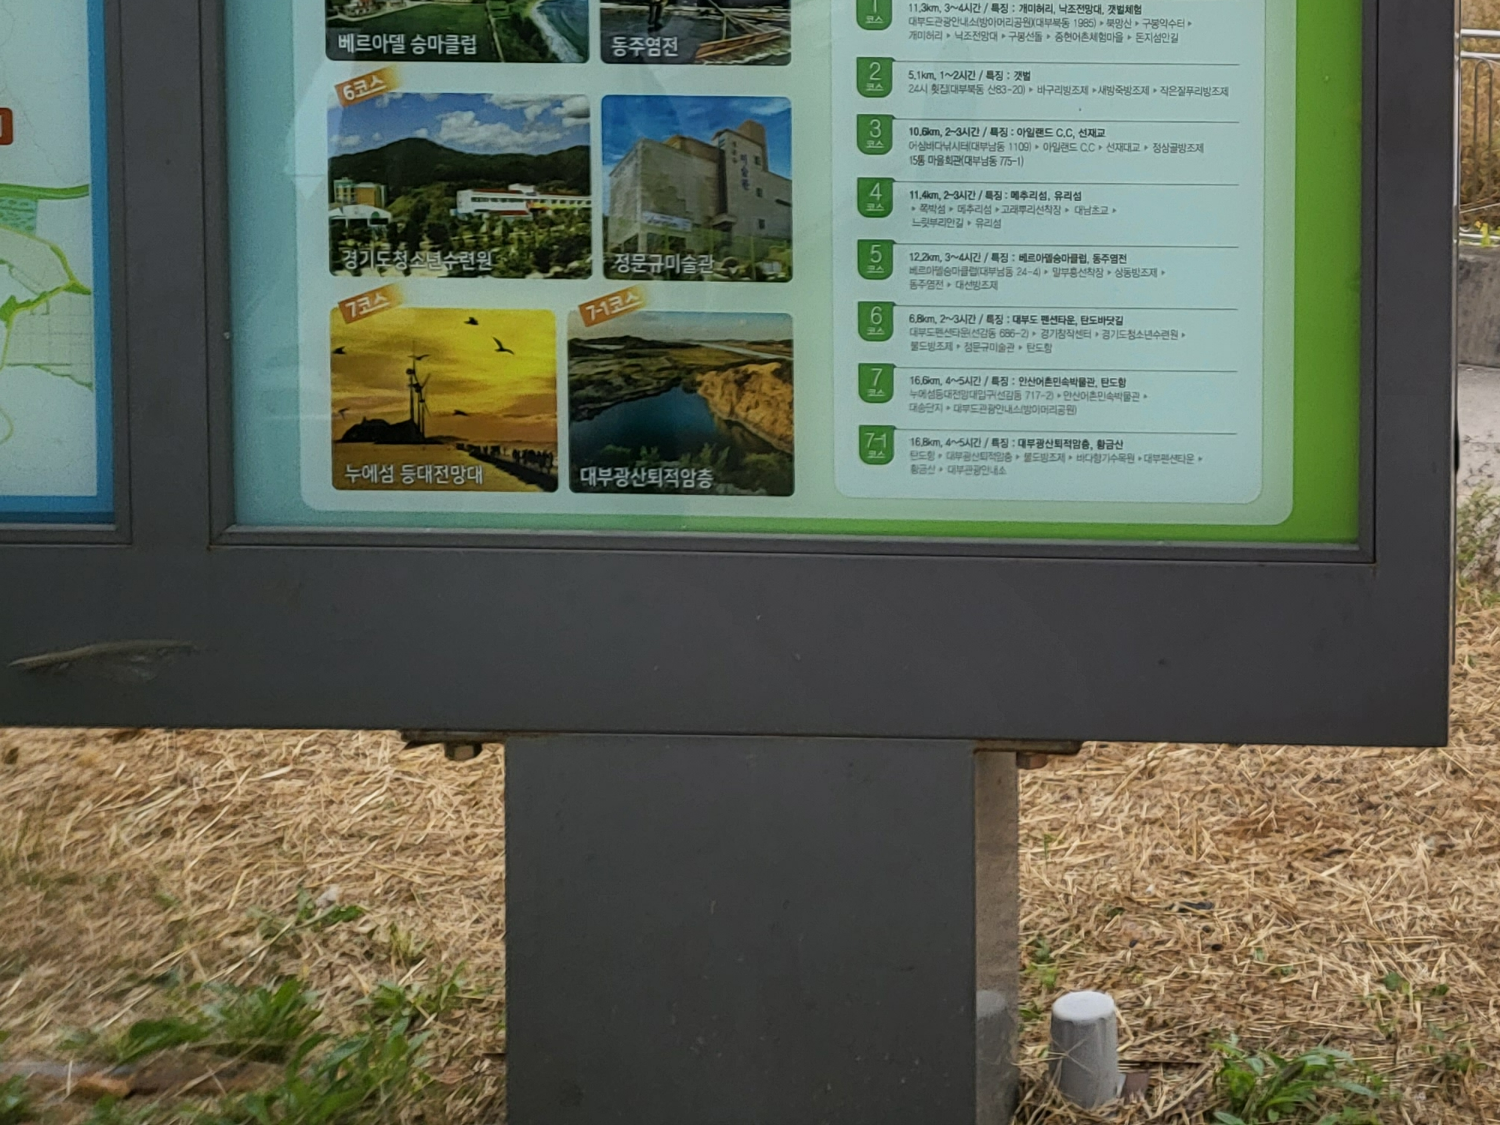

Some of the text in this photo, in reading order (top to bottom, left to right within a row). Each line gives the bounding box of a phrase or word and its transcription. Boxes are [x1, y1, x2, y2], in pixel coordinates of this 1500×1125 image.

[338, 33, 477, 55] 베르아델 승마클럽
[612, 36, 679, 58] 동주염전
[869, 63, 881, 80] 2
[342, 75, 387, 102] 6코스
[869, 121, 881, 137] 3
[868, 183, 882, 199] 4
[343, 249, 493, 271] 경기도청소년수련원
[614, 253, 715, 274] 정문규미술관
[869, 246, 882, 262] 5
[345, 291, 390, 318] 7코스
[584, 291, 642, 320] 7-1코스
[869, 307, 882, 324] 6
[870, 369, 883, 385] 7
[865, 433, 887, 448] 7-1
[344, 464, 483, 486] 누에섬 등대전망대
[580, 467, 713, 488] 대부광산퇴적암층
